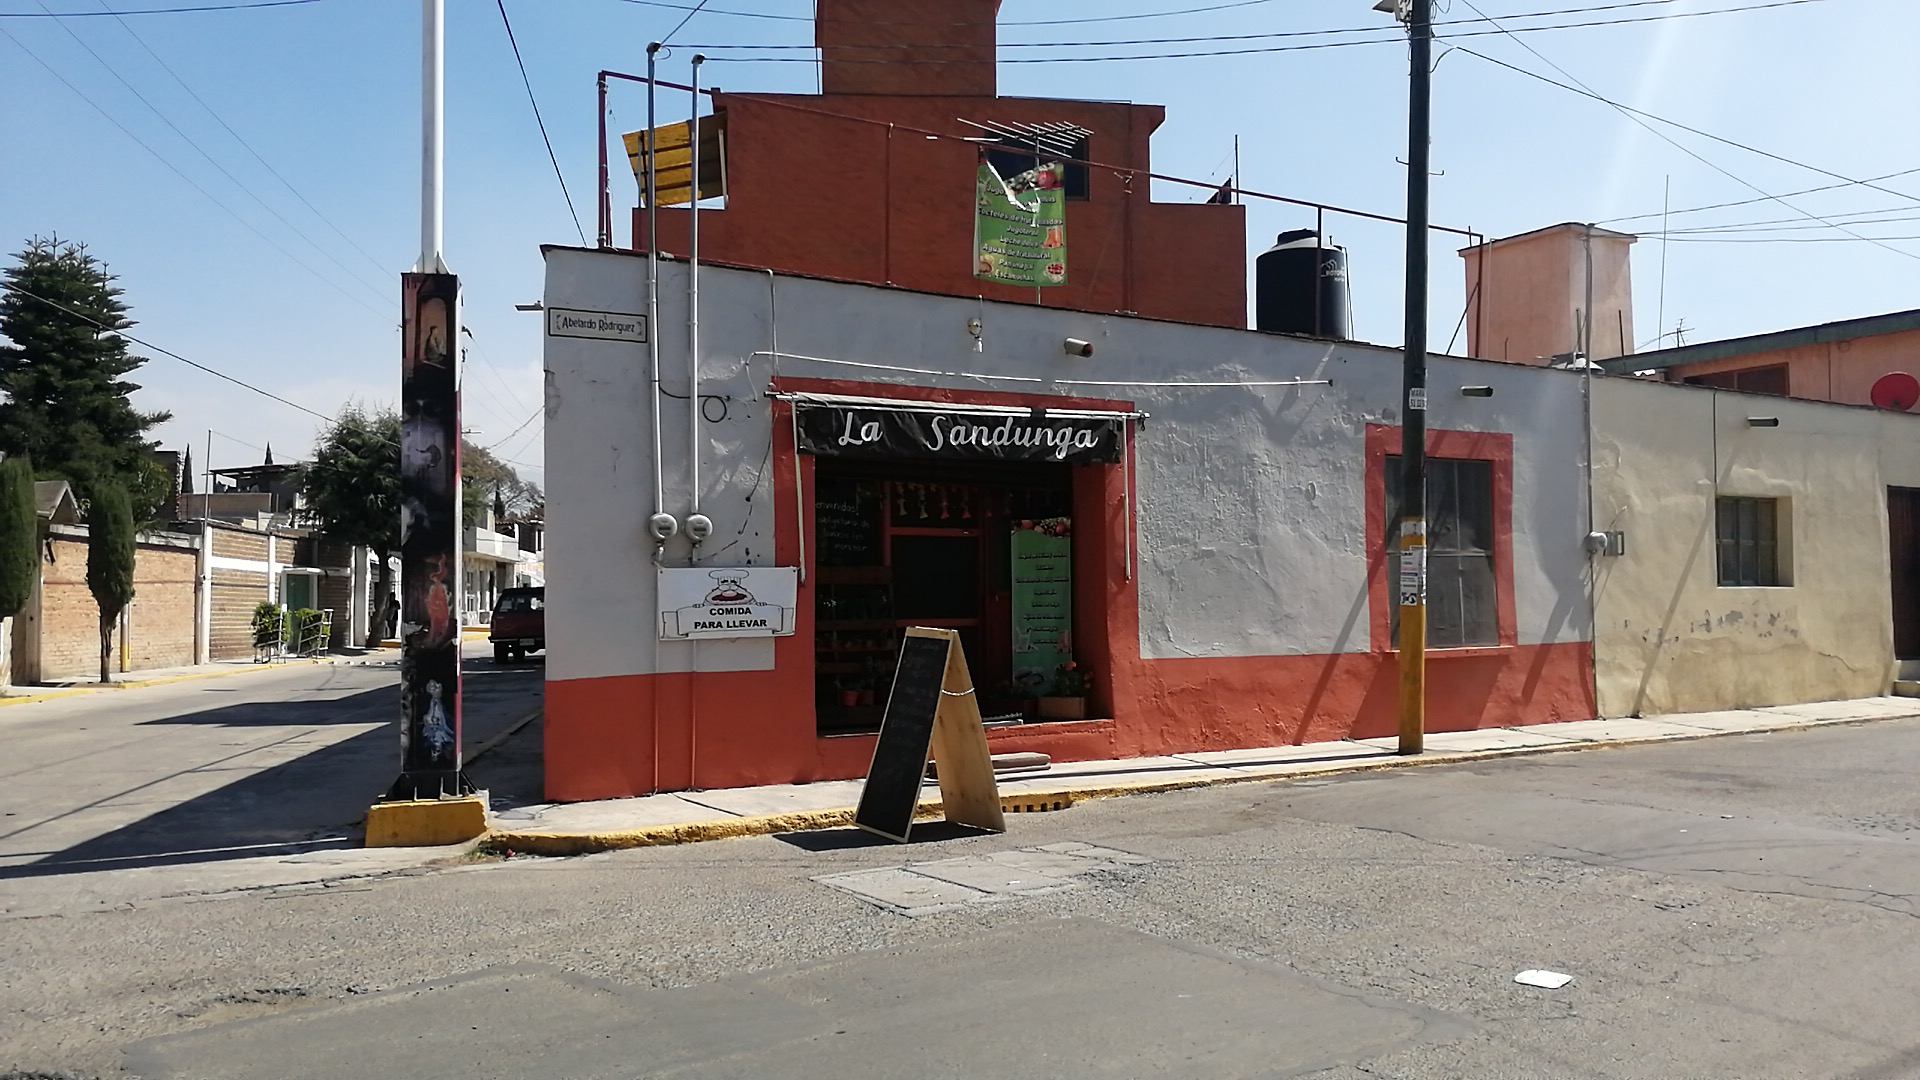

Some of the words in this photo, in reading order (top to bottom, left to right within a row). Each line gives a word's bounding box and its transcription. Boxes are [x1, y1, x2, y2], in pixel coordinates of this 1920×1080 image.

[982, 243, 1007, 255] Aguas
[562, 315, 597, 330] Abelardo
[838, 411, 884, 447] La
[924, 414, 1101, 460] Sandunga
[709, 607, 752, 616] COMIDA
[694, 621, 723, 629] PARA
[726, 619, 768, 629] LLEVAR
